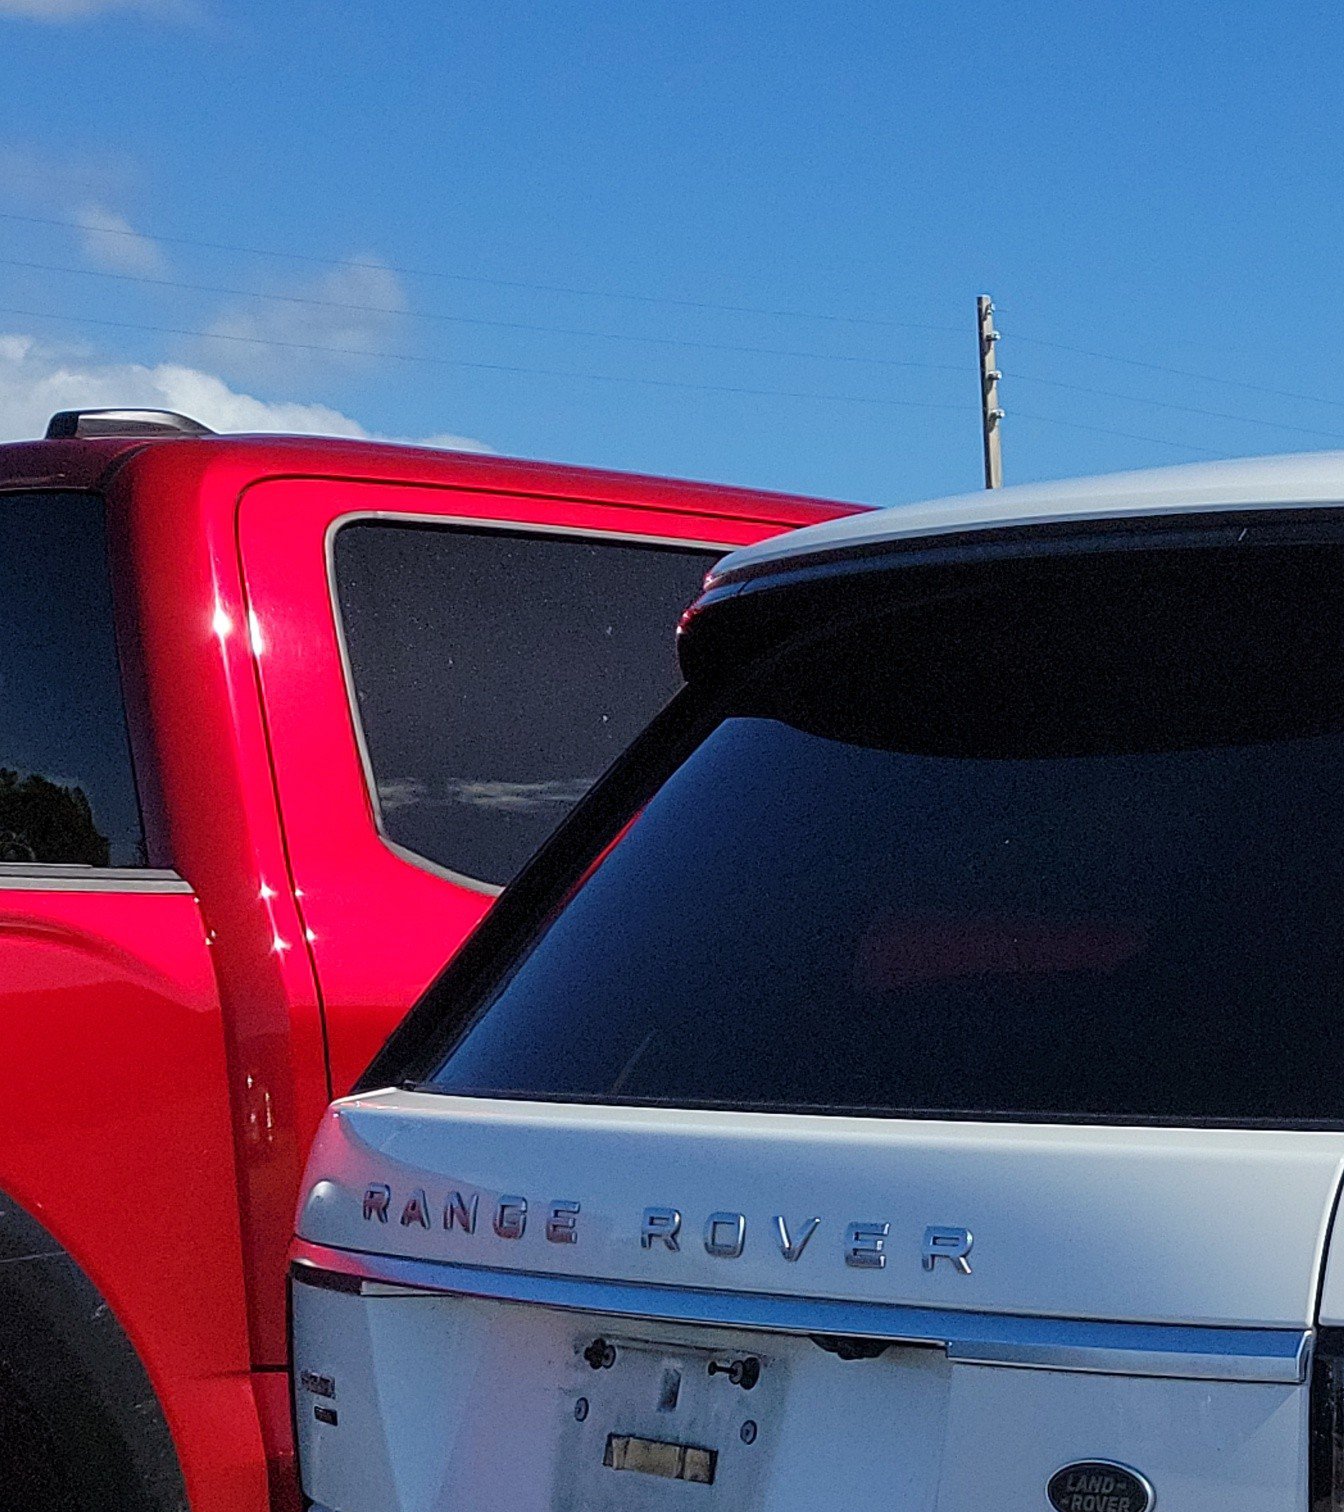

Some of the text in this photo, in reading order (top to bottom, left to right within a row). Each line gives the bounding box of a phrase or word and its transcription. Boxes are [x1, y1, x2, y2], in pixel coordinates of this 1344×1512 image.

[362, 1182, 976, 1275] RANGE ROVER
[1066, 1472, 1115, 1494] LAND
